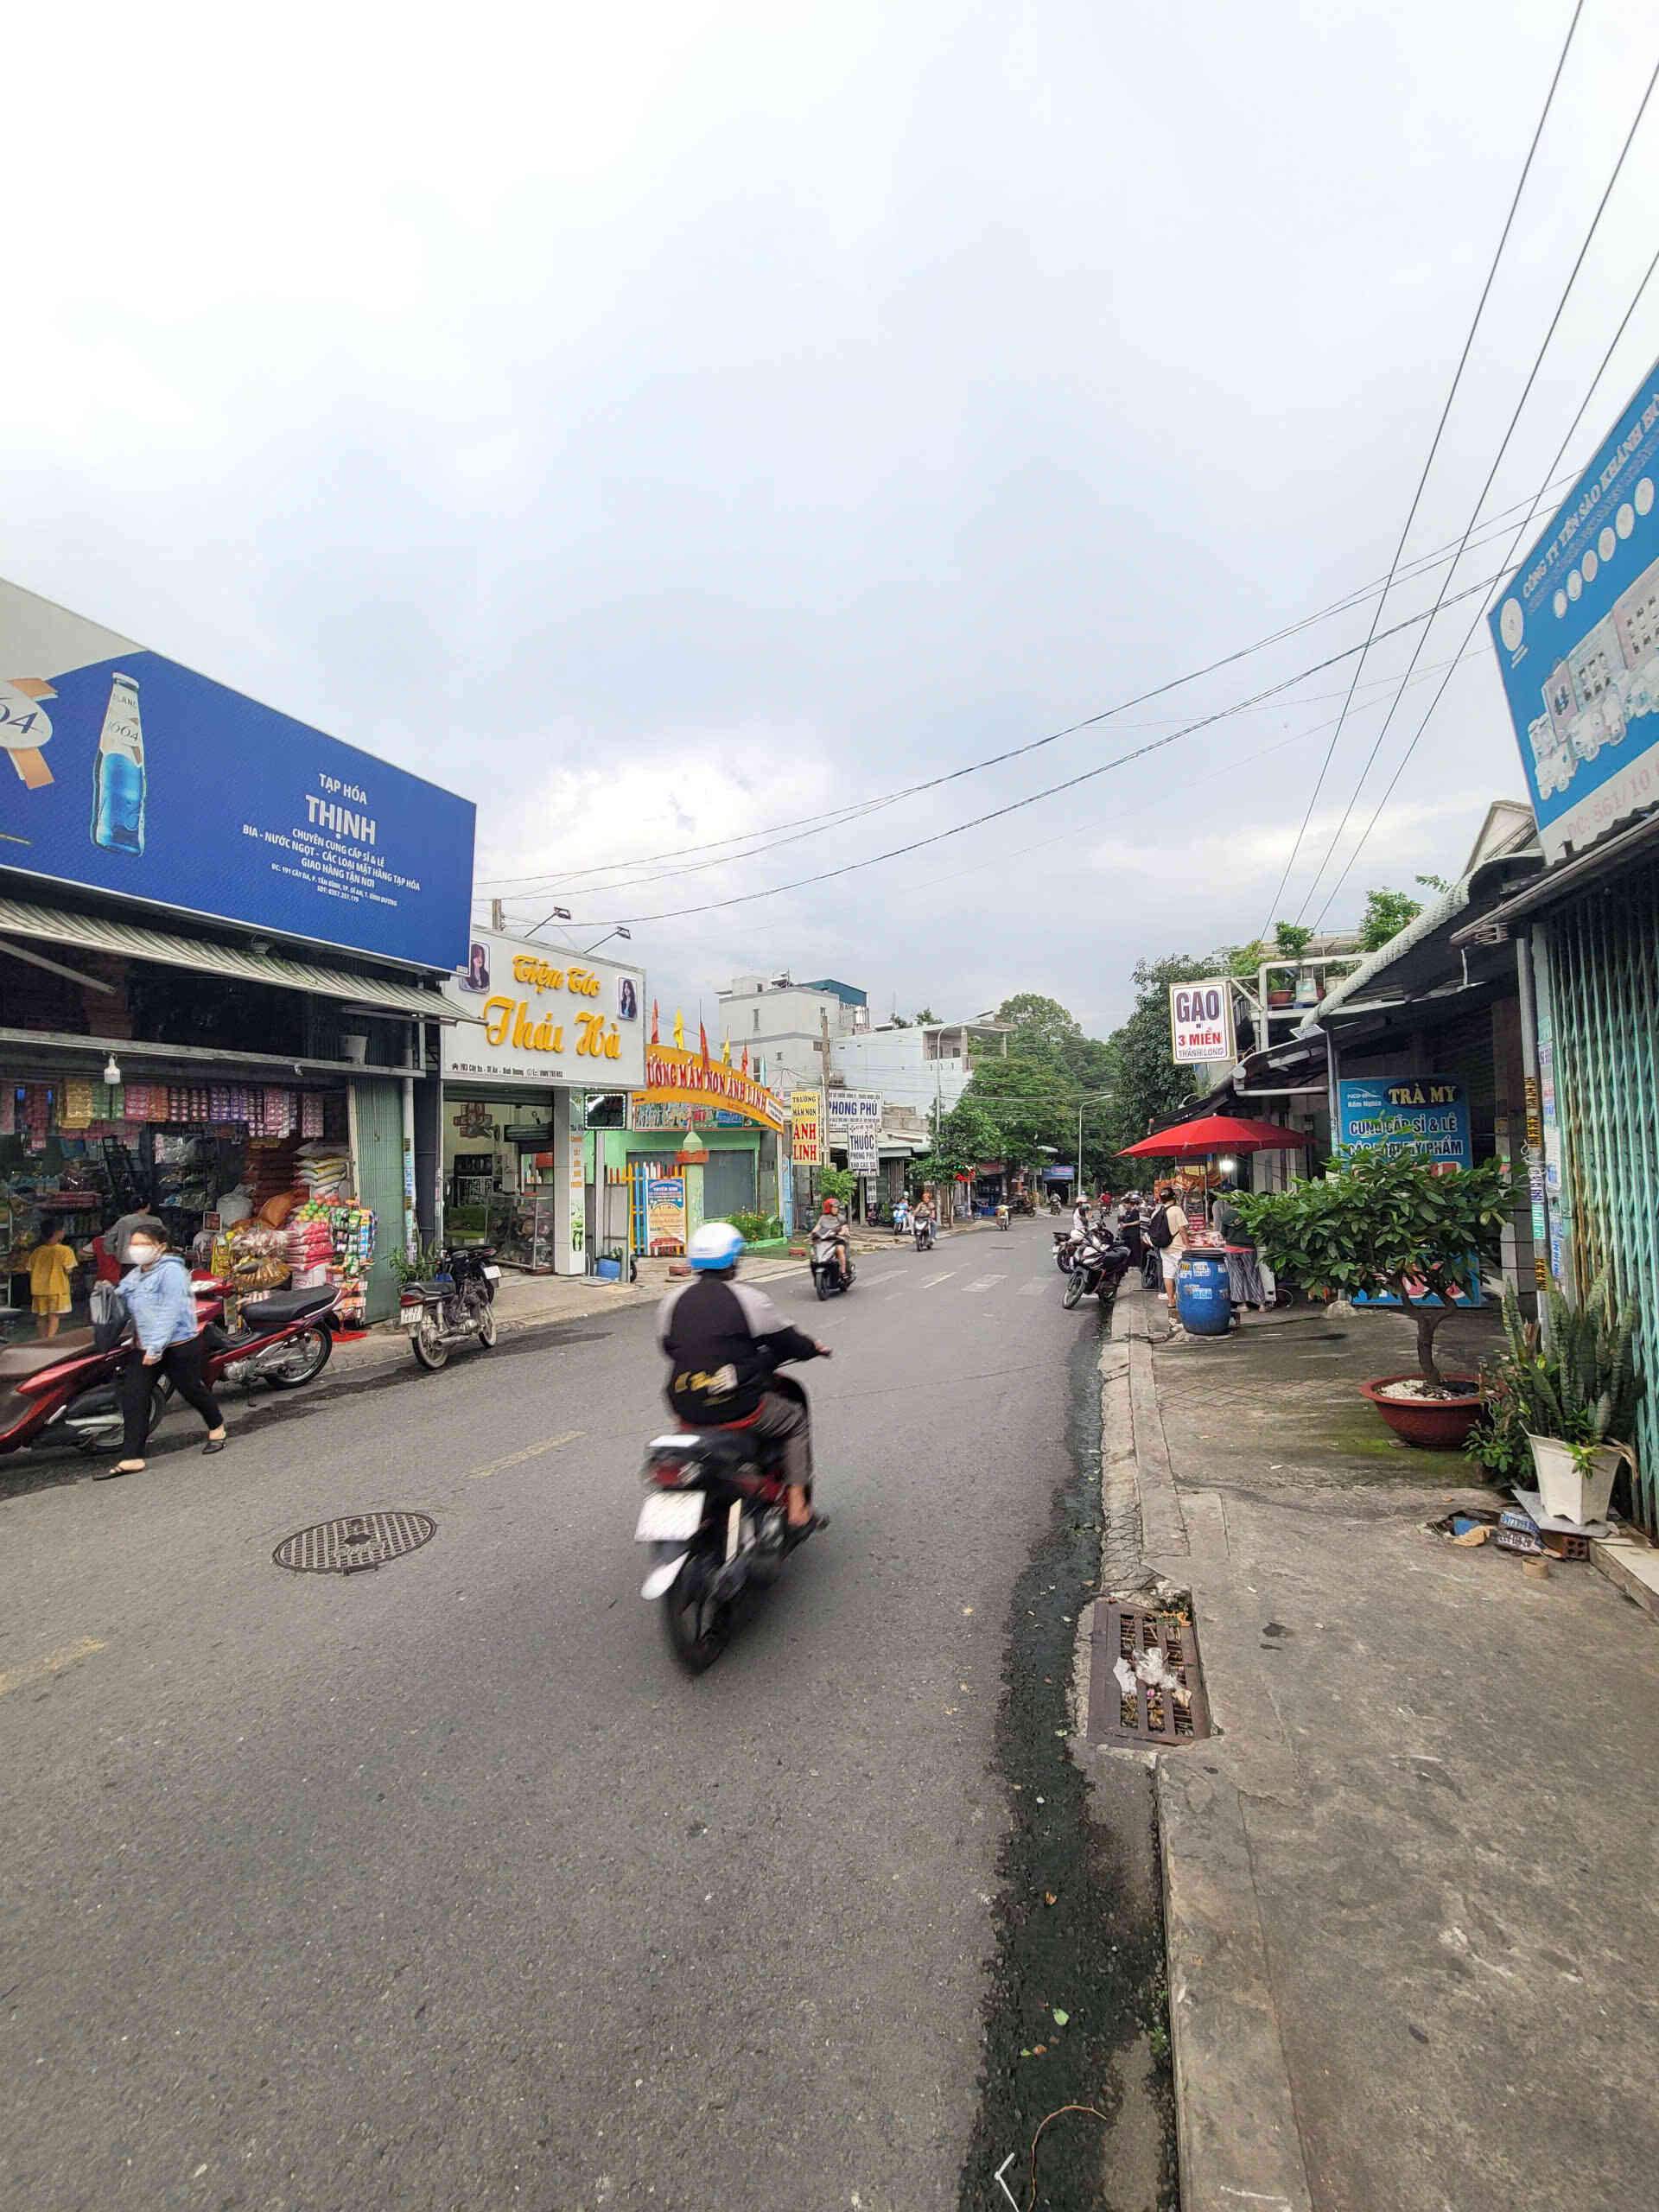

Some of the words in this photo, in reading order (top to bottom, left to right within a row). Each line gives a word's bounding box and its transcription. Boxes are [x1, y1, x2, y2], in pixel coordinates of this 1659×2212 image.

[1546, 541, 1560, 566] TY
[319, 773, 340, 793] TẠP
[343, 785, 367, 804] HÓA
[305, 794, 376, 844] THỊNH
[243, 824, 258, 838] BIA
[264, 831, 290, 849] NƯỚC
[292, 841, 315, 857] NGỌT
[338, 857, 354, 871] LOẠI
[372, 868, 392, 882] HÀNG
[292, 828, 324, 847] CHUYÊN
[325, 840, 346, 855] CUNG
[348, 846, 363, 861] CẤP
[301, 857, 321, 871] GIAO
[322, 863, 345, 879] HÀNG
[567, 968, 601, 997] Tóc
[1176, 990, 1219, 1029] GẠO
[484, 996, 565, 1053] Thái
[574, 1012, 622, 1059] Hà
[1178, 1035, 1185, 1046] 3
[1189, 1027, 1222, 1046] MIỀN
[647, 1052, 677, 1088] ƯỜNG
[705, 1070, 726, 1094] NON
[746, 1084, 767, 1113] LINH
[1389, 1083, 1426, 1105] TRÀ
[1430, 1085, 1457, 1103] MY
[794, 1119, 817, 1140] ÁNH
[1429, 1118, 1439, 1132] &
[793, 1144, 817, 1161] LINH
